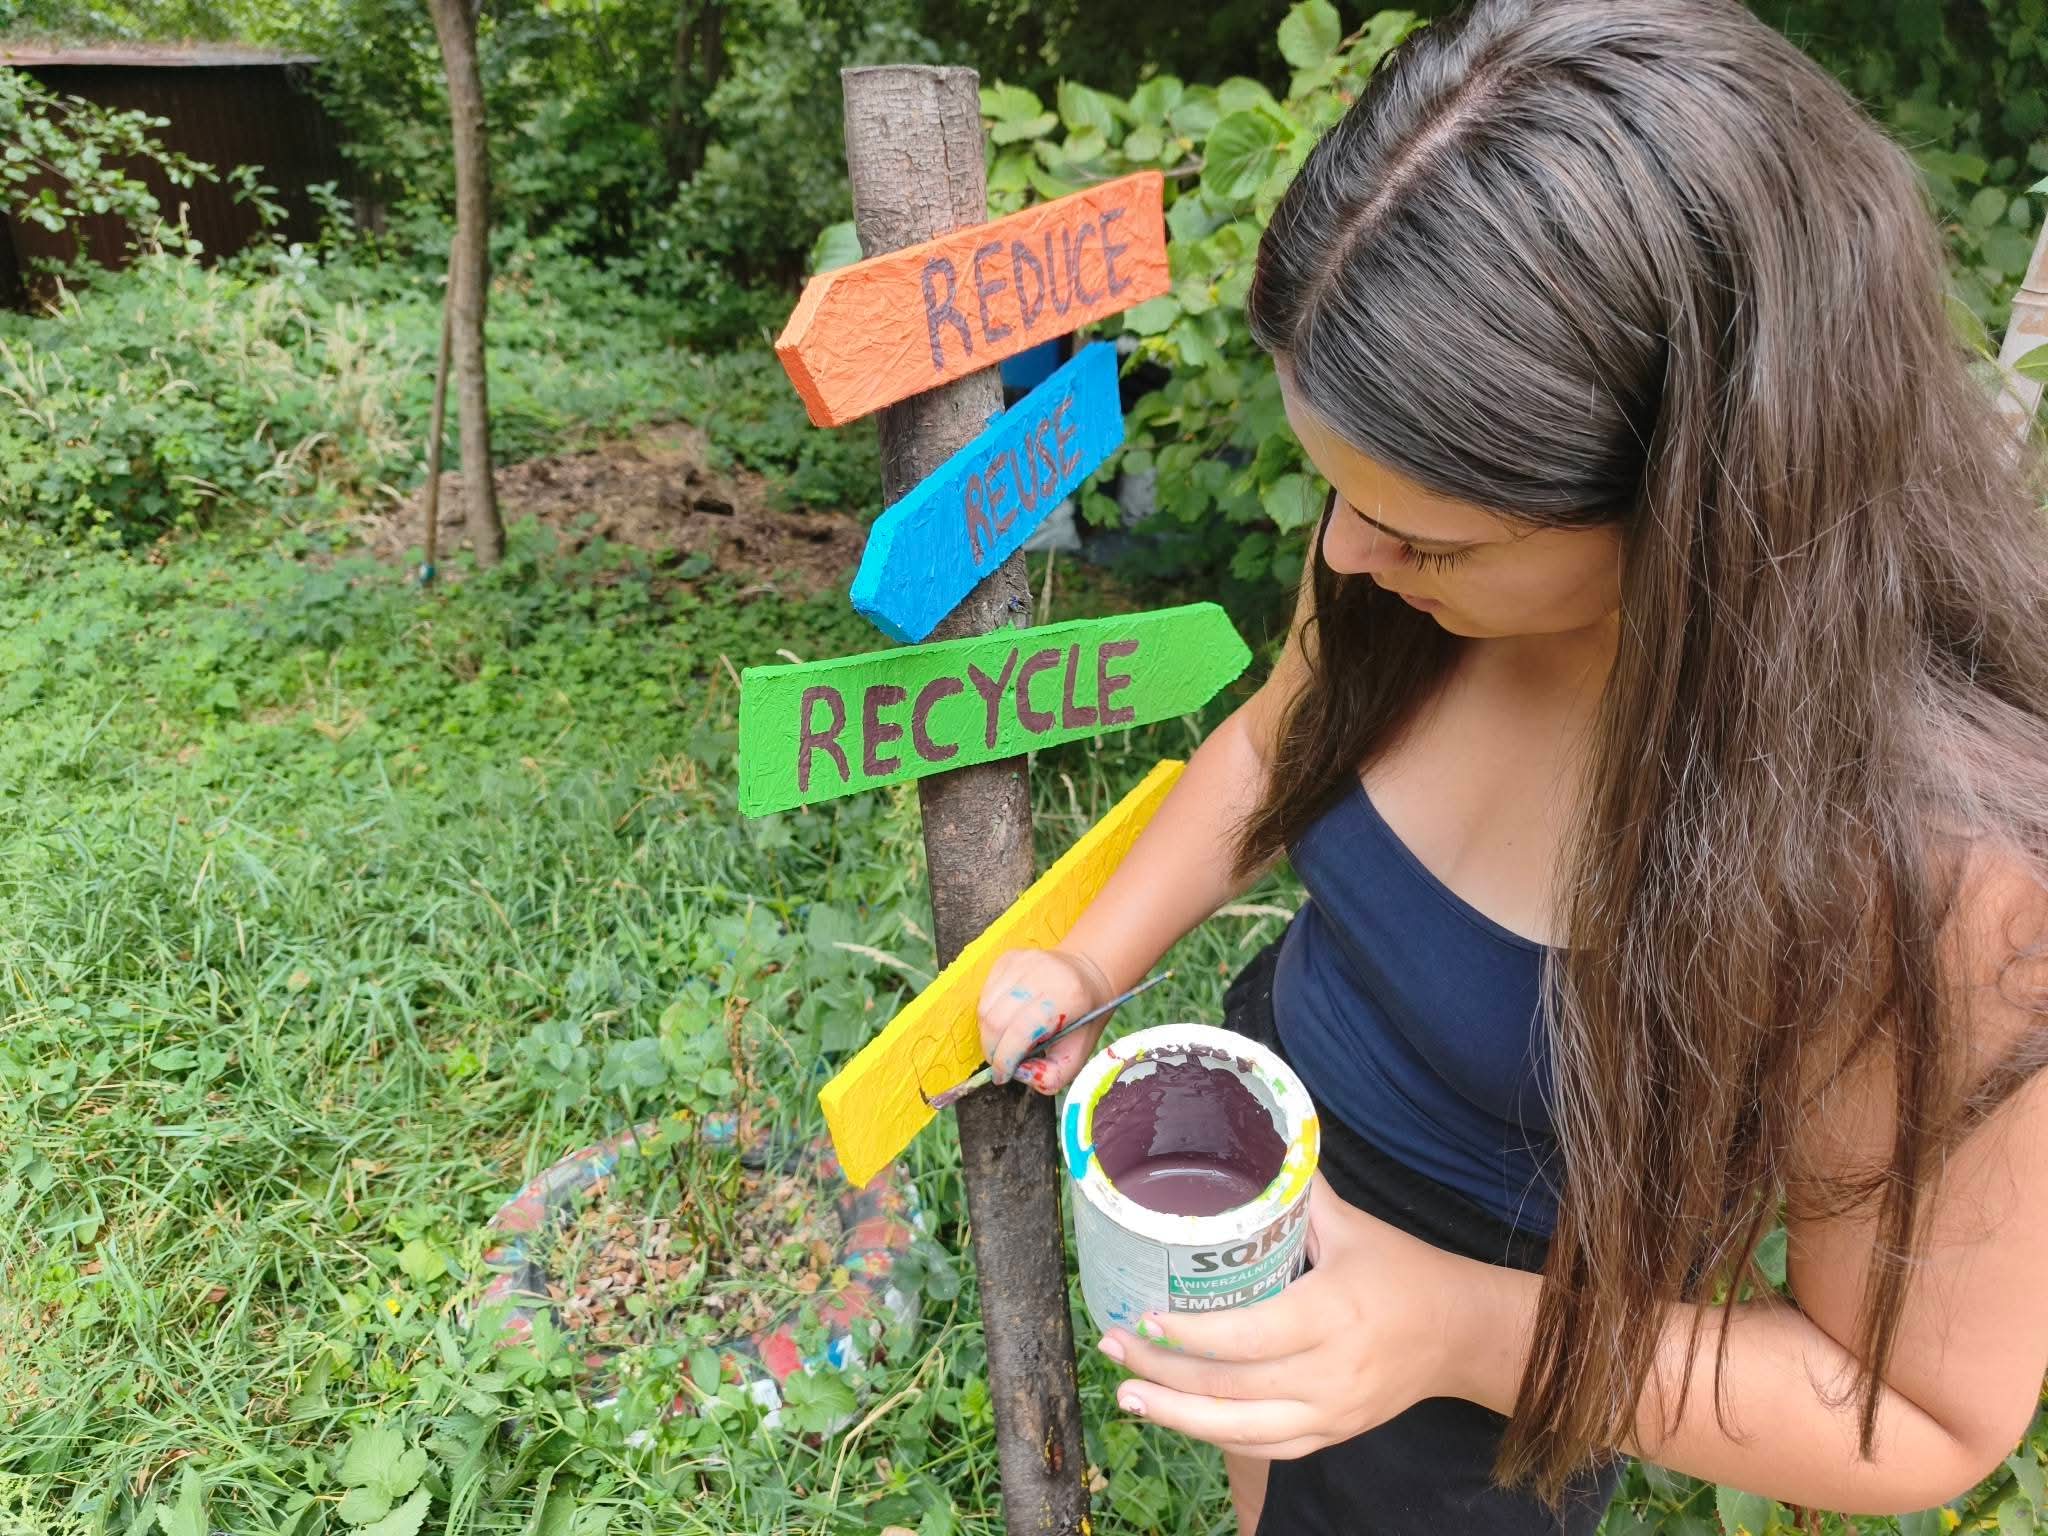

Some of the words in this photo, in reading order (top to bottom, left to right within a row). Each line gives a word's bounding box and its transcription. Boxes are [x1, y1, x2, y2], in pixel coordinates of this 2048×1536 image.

[920, 208, 1132, 373] REDUCE
[964, 394, 1082, 566] REUSE
[799, 640, 1139, 792] RECYCLE
[1174, 1291, 1246, 1309] EMAIL
